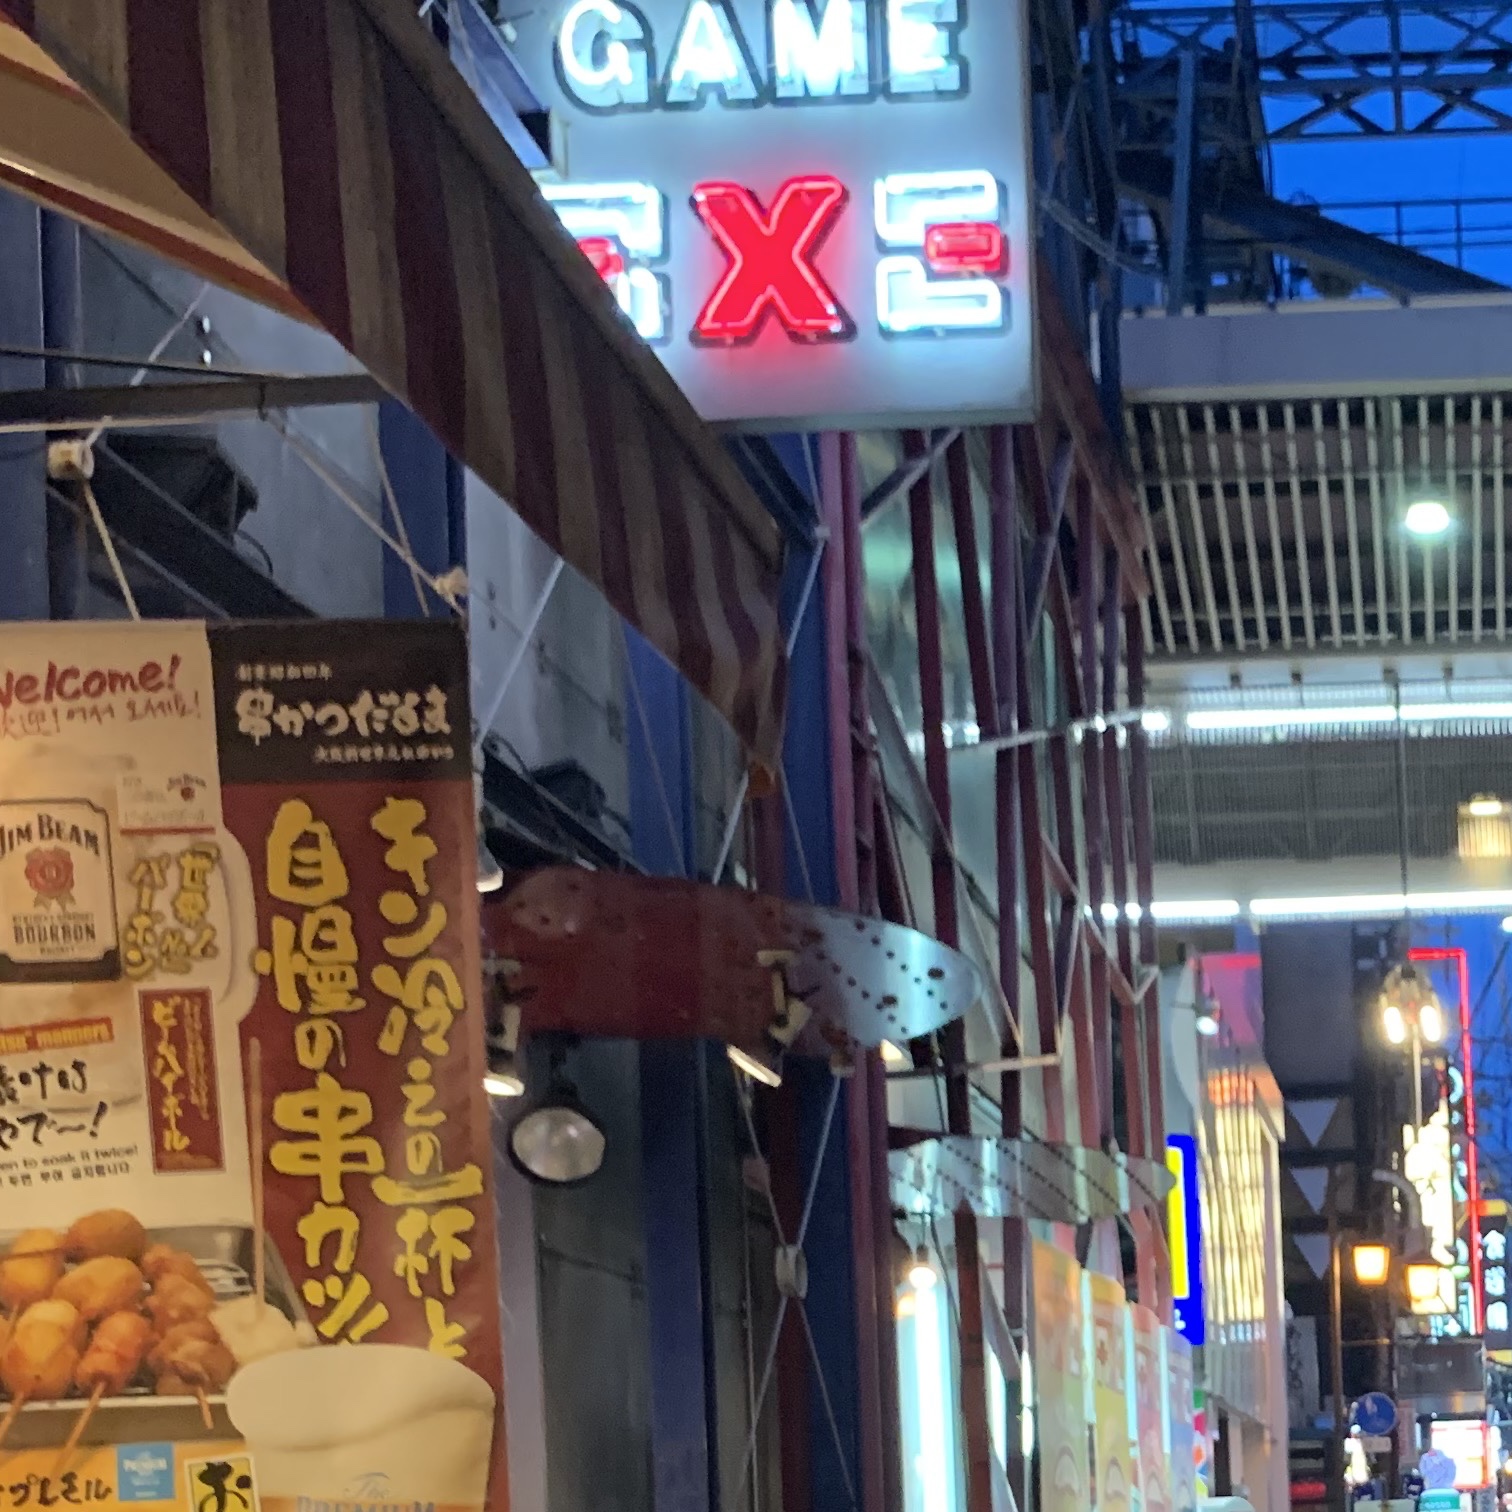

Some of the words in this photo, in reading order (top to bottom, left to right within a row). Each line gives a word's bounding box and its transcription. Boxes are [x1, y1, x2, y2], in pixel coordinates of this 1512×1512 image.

[553, 0, 969, 115] GAME
[236, 684, 450, 746] 串かつだるま
[38, 813, 99, 857] BEAM
[14, 923, 96, 944] BOURBON
